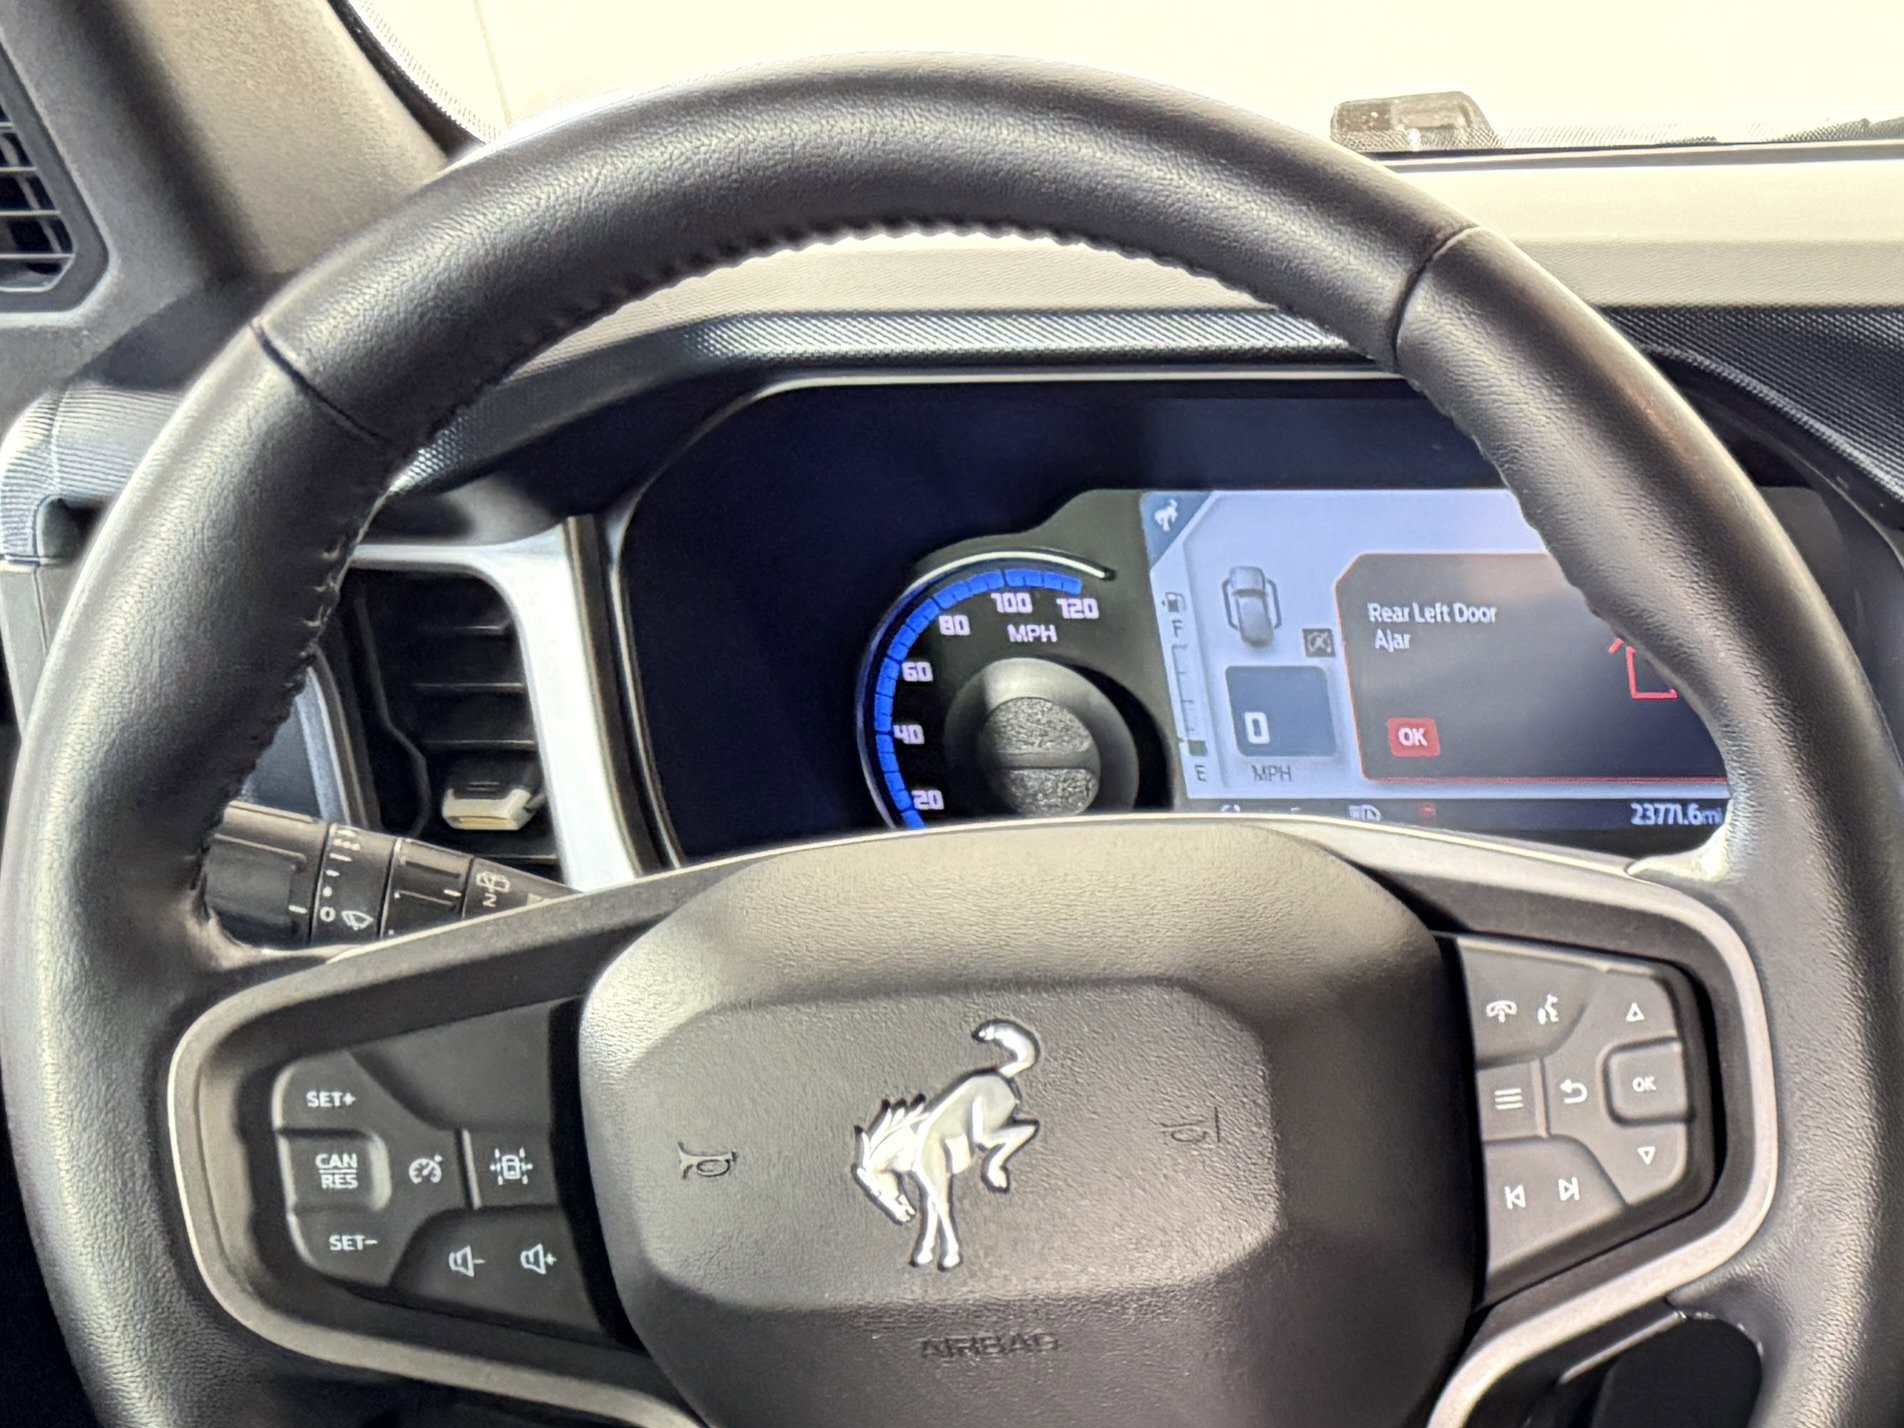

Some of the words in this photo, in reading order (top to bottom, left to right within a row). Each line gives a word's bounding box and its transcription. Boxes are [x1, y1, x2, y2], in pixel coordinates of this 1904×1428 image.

[991, 592, 1033, 614] 100
[1056, 598, 1099, 620] 120
[1367, 602, 1409, 624] Rear
[1413, 601, 1450, 624] Left
[1453, 602, 1497, 624] Door
[938, 614, 971, 636] 80
[1007, 623, 1058, 643] MPH
[1173, 619, 1184, 637] F
[1374, 628, 1411, 652] Ajar
[901, 660, 934, 682] 60
[893, 724, 925, 745] 40
[1244, 711, 1270, 745] 0
[1398, 727, 1429, 747] OK
[1195, 765, 1207, 782] E
[1253, 765, 1292, 782] MPH
[911, 789, 945, 810] 20
[1632, 1075, 1657, 1092] OK
[306, 1091, 356, 1108] SET+
[315, 1153, 358, 1169] CAN
[320, 1174, 359, 1189] RES
[921, 1332, 1060, 1359] AIRBAG
